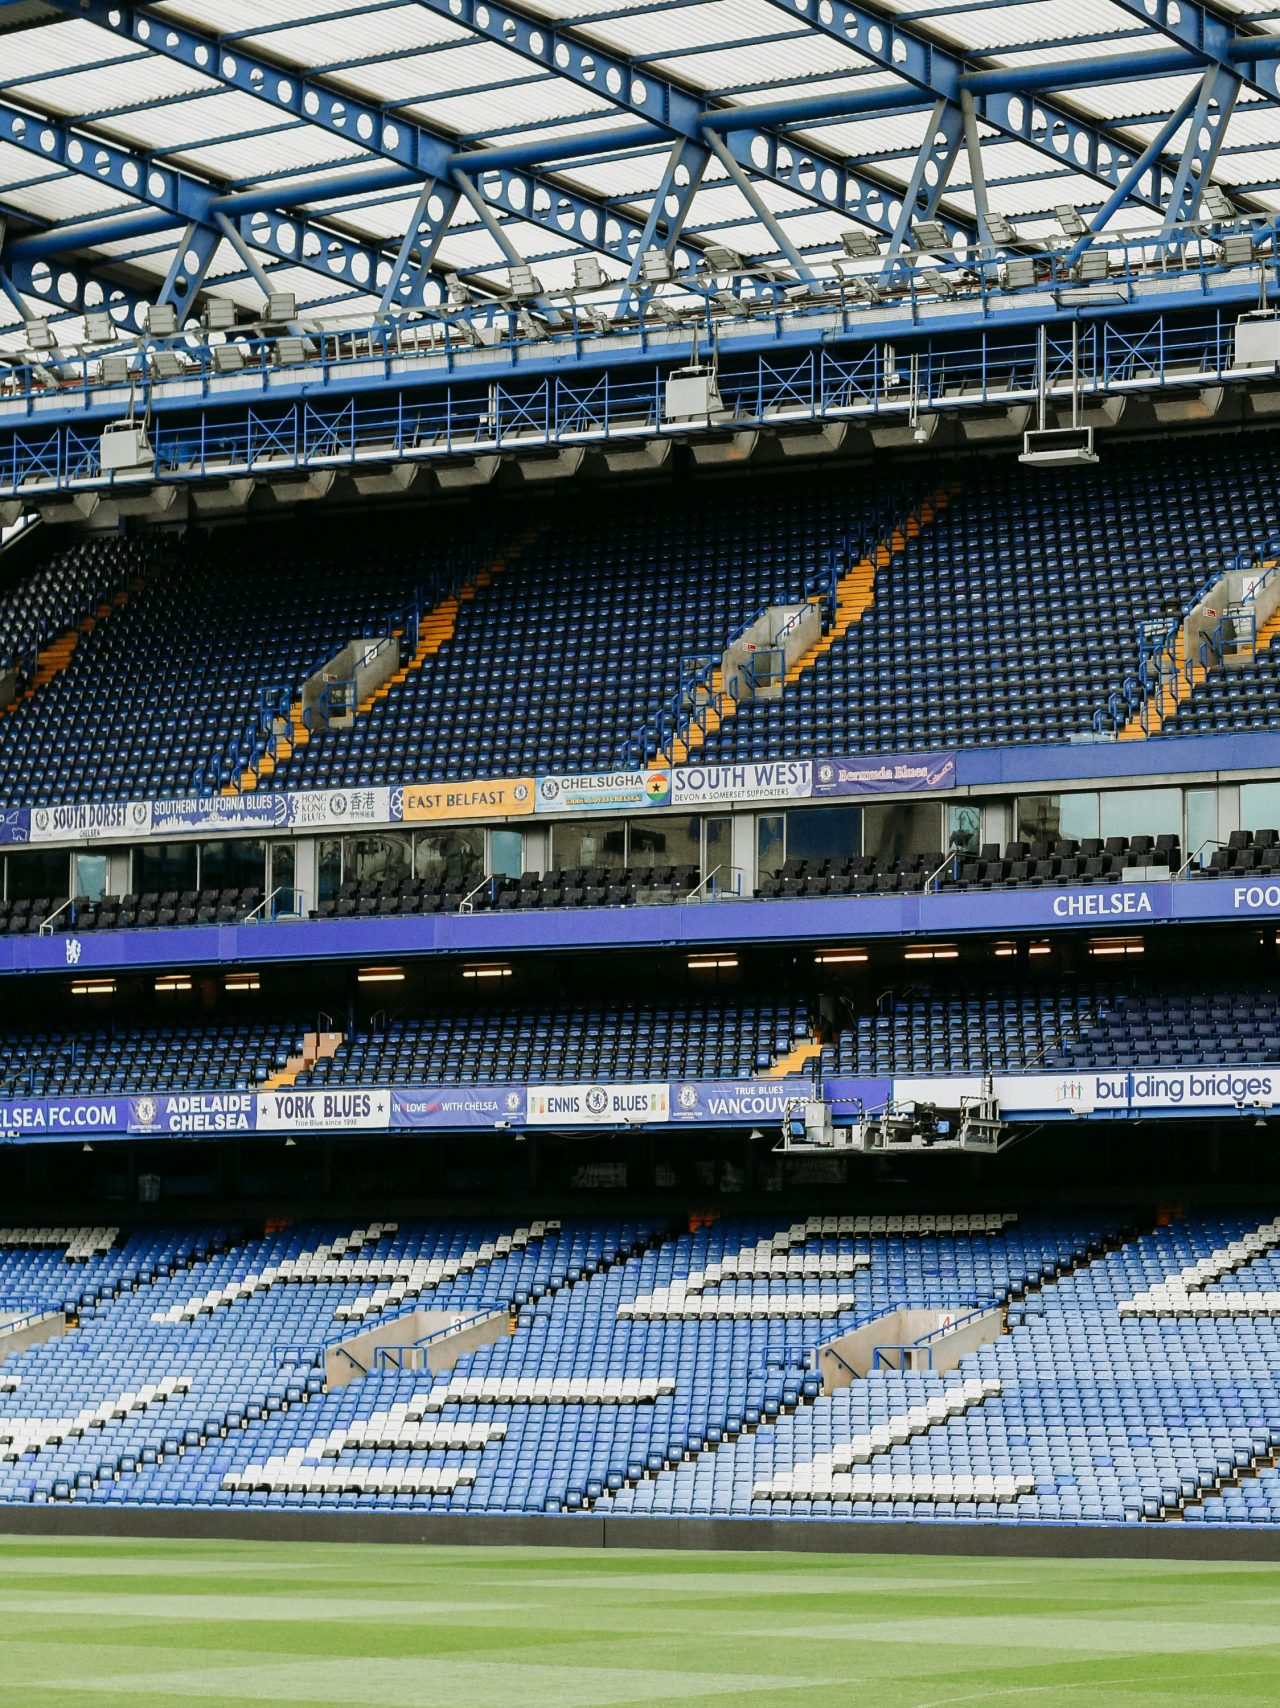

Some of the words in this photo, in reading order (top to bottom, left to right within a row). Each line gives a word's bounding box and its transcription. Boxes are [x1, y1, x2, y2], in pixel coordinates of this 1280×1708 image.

[561, 775, 644, 790] CHELSUGHA
[675, 767, 745, 791] SOUTH
[754, 762, 810, 786] WEST
[838, 767, 893, 783] Bermuda
[894, 764, 928, 780] Blues
[301, 793, 327, 803] HONG
[349, 791, 375, 811] 香港
[408, 794, 442, 809] EAST
[446, 790, 506, 807] BELFAST
[675, 793, 700, 802] DEVON
[709, 790, 744, 800] SOMERSET
[746, 787, 790, 798] SUPPORTERS
[154, 799, 197, 816] SOUTHERN
[198, 796, 244, 812] CALIFORNIA
[246, 794, 273, 810] BLUES
[301, 803, 327, 813] KONG
[53, 806, 86, 830] SOUTH
[89, 802, 128, 828] DORSET
[301, 812, 326, 822] BLUES
[79, 829, 101, 838] CHELSEA
[1053, 892, 1152, 917] CHELSEA
[734, 1086, 756, 1096] TRUE
[759, 1085, 784, 1095] BLUES
[1096, 1075, 1184, 1103] building
[1189, 1073, 1272, 1101] bridges
[166, 1095, 252, 1113] ADELAIDE
[274, 1096, 315, 1119] YORK
[323, 1094, 371, 1117] BLUES
[392, 1103, 401, 1112] IN
[441, 1102, 463, 1111] WITH
[464, 1101, 499, 1111] CHELSEA
[547, 1096, 580, 1113] ENNIS
[613, 1094, 648, 1112] BLUES
[169, 1112, 249, 1131] CHELSEA
[295, 1119, 309, 1127] True
[309, 1119, 324, 1127] Blue
[325, 1118, 342, 1126] since
[454, 1318, 462, 1331] 3
[943, 1316, 951, 1330] 4
